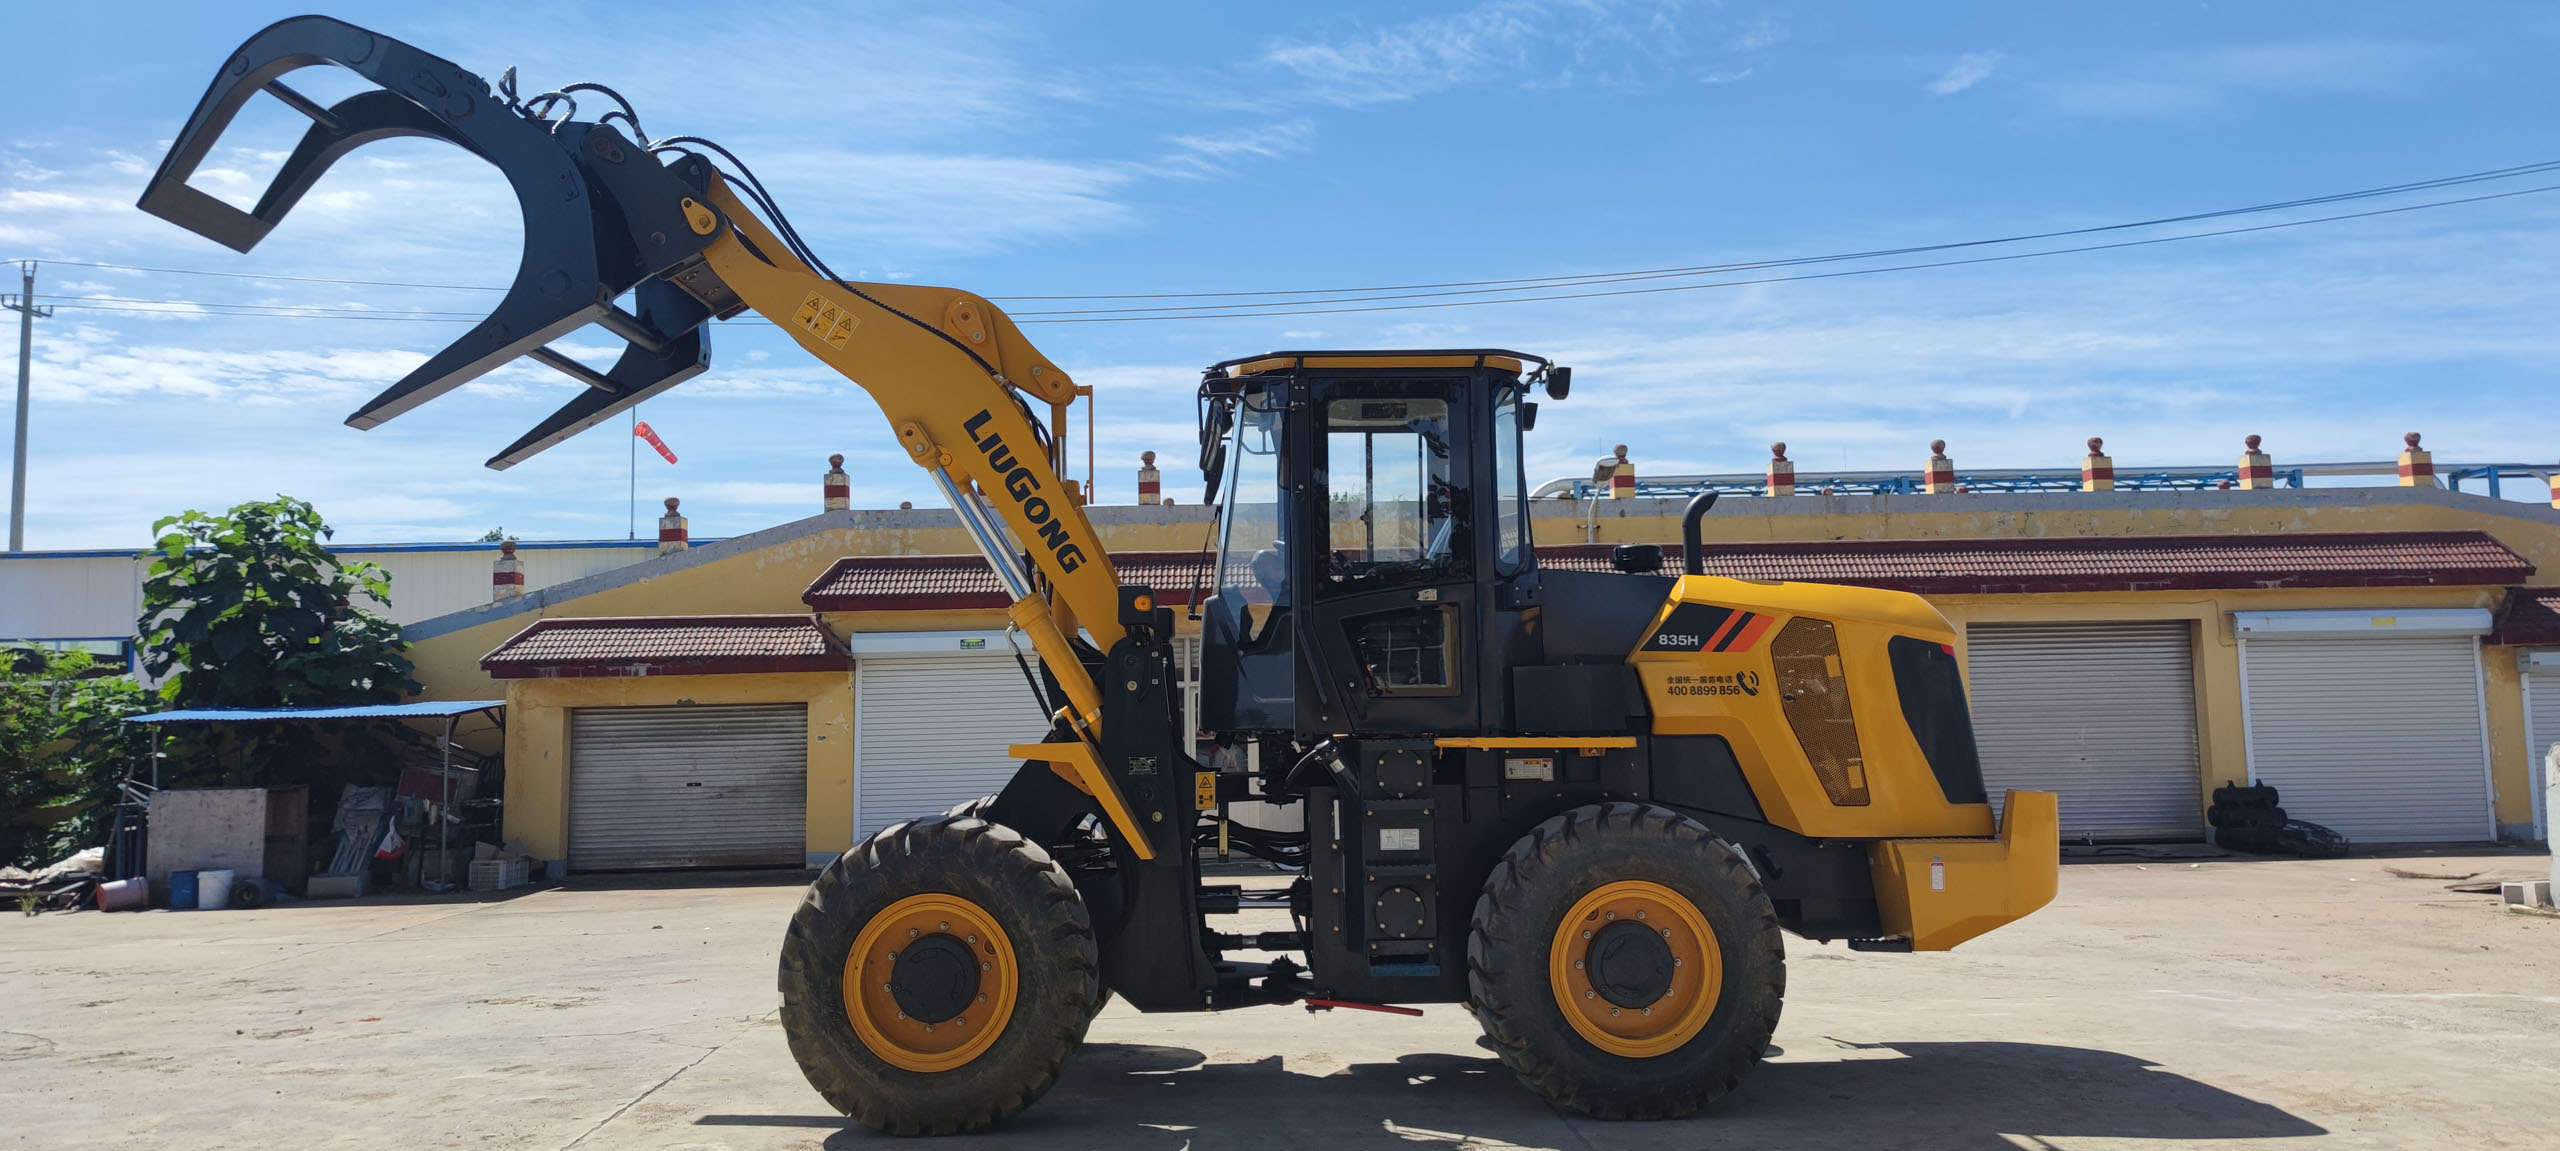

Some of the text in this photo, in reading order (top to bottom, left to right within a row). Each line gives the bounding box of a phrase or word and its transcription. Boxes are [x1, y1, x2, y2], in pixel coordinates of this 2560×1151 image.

[1658, 634, 1699, 646] 835H
[1667, 685, 1740, 696] 400 8899 856
